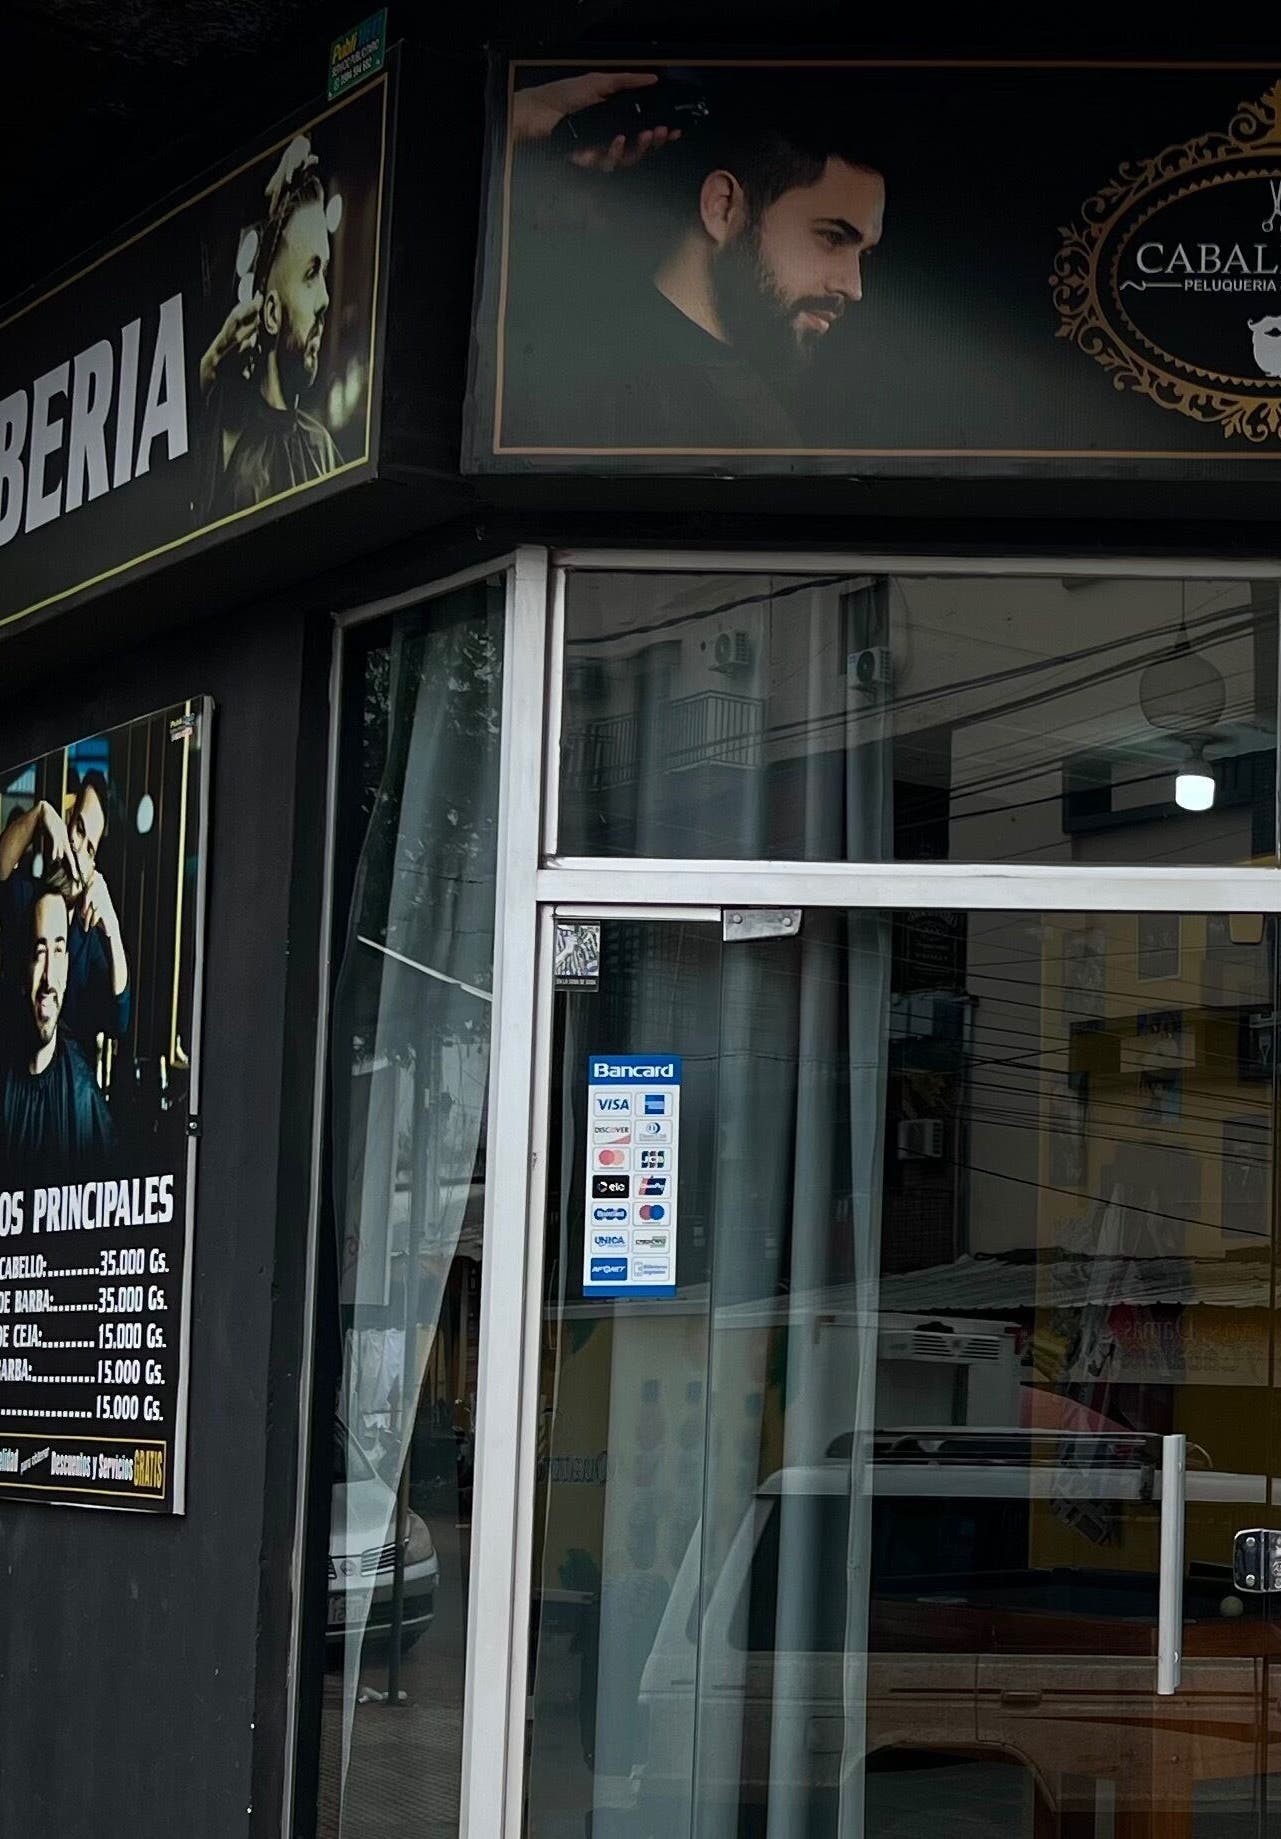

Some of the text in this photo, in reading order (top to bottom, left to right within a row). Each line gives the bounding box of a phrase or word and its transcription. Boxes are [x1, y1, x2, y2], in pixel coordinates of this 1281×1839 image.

[1184, 279, 1277, 293] PELUQUERIA
[0, 292, 188, 547] BERIA
[594, 1063, 674, 1078] Bancard
[597, 1099, 630, 1110] VISA
[594, 1126, 629, 1134] DISCOVER
[0, 1174, 174, 1237] OS PRINCIPALES
[99, 1248, 145, 1276] 35.000
[149, 1248, 169, 1274] Gs.
[97, 1286, 143, 1313] 35.000
[147, 1285, 168, 1310] Gs.
[98, 1323, 142, 1349] 15.000
[146, 1323, 167, 1348] Gs.
[0, 1358, 165, 1384] ARBA: 15.000 Gs.
[96, 1395, 164, 1421] 15.000 Gs.
[133, 1449, 163, 1488] GRATIS
